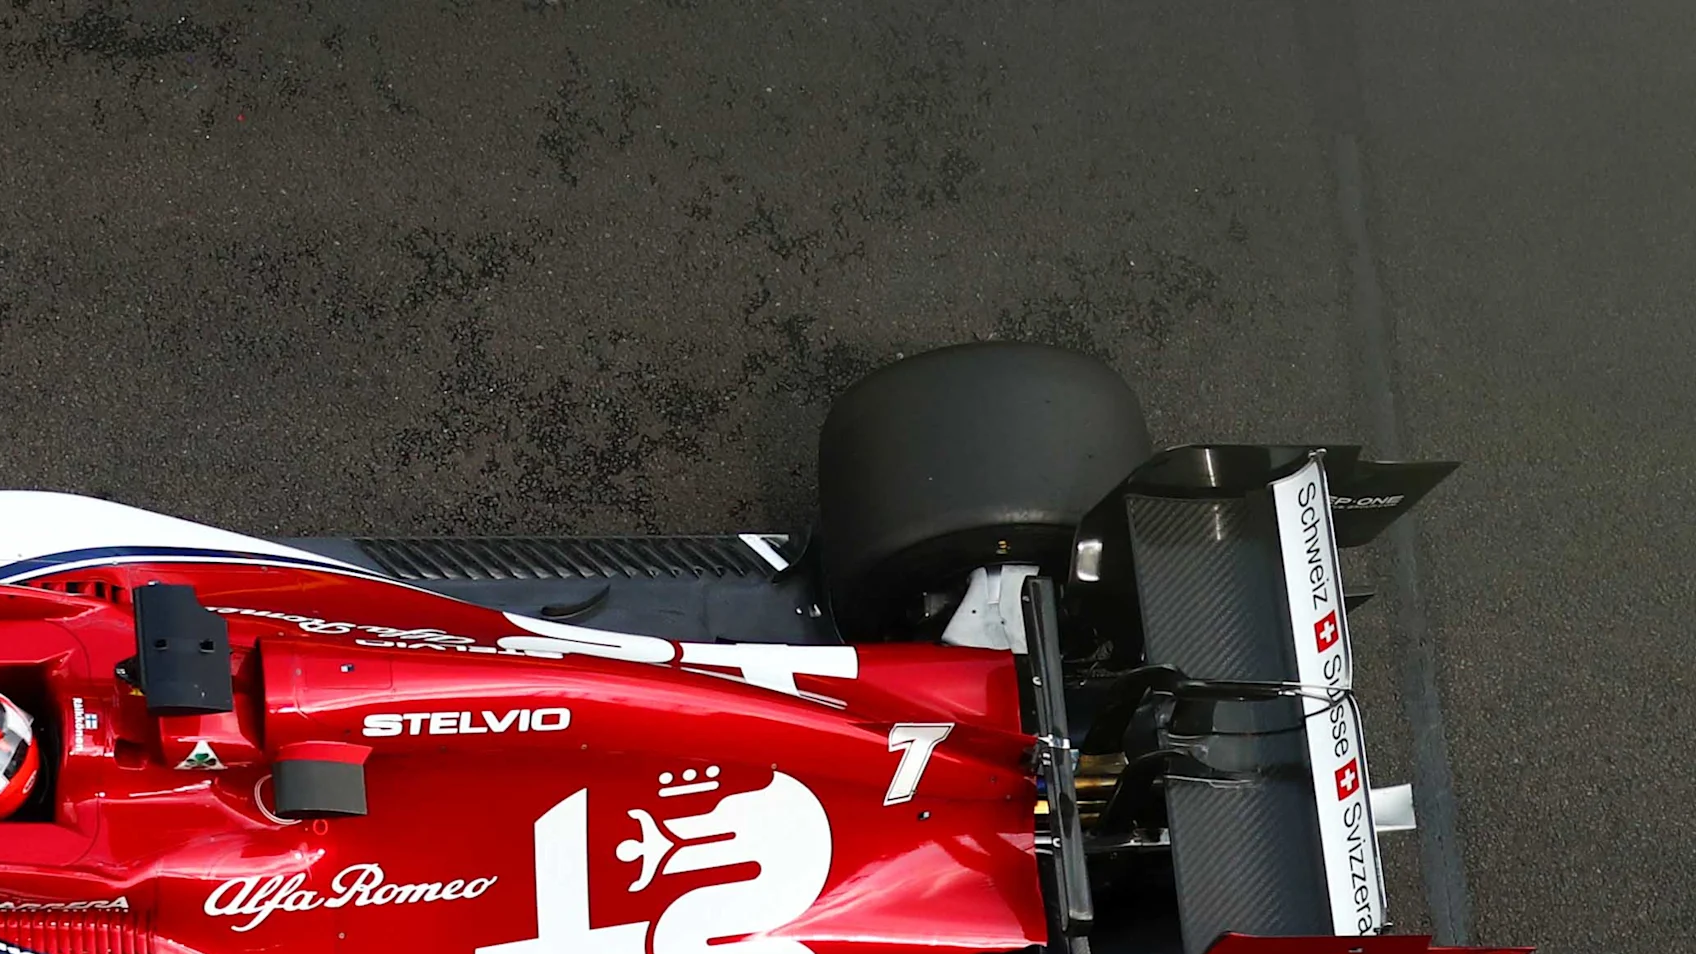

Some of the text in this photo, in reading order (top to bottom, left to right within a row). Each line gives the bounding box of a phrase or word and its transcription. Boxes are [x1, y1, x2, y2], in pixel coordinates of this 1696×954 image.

[1297, 481, 1332, 610] Schweiz
[362, 707, 572, 738] STELVIO
[1323, 654, 1350, 758] Susse
[883, 722, 955, 806] 7
[203, 863, 498, 933] Alfa Romeo
[1343, 801, 1374, 936] Svizzera
